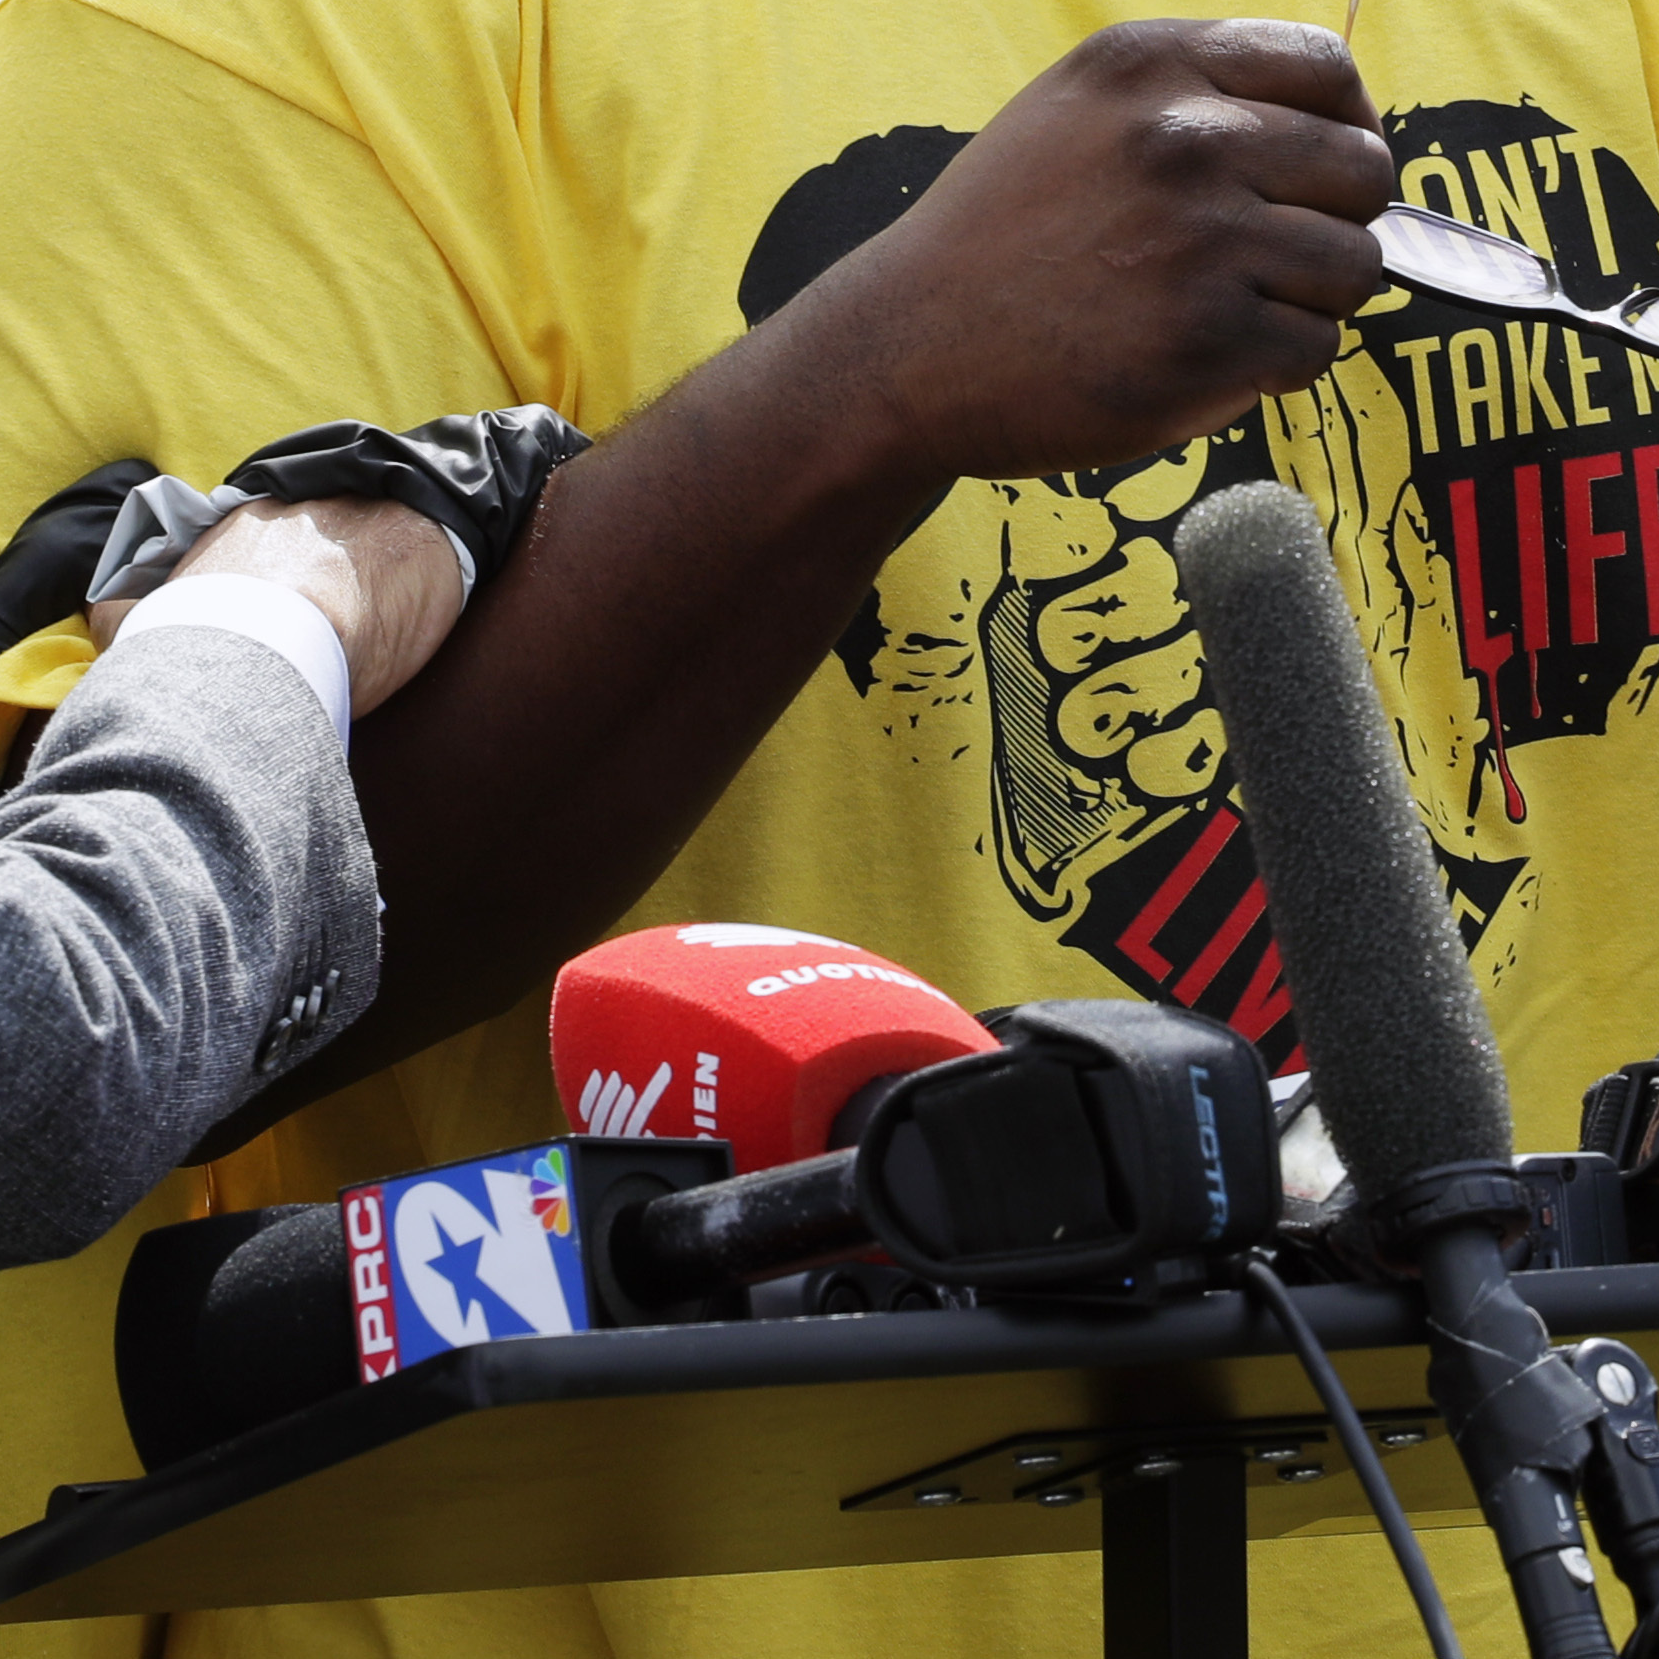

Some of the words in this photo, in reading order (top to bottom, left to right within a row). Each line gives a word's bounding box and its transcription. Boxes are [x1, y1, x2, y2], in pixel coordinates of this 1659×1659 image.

[1354, 134, 1620, 317] ON'T
[1394, 320, 1611, 455] TAKE
[1114, 806, 1311, 1079] LIV
